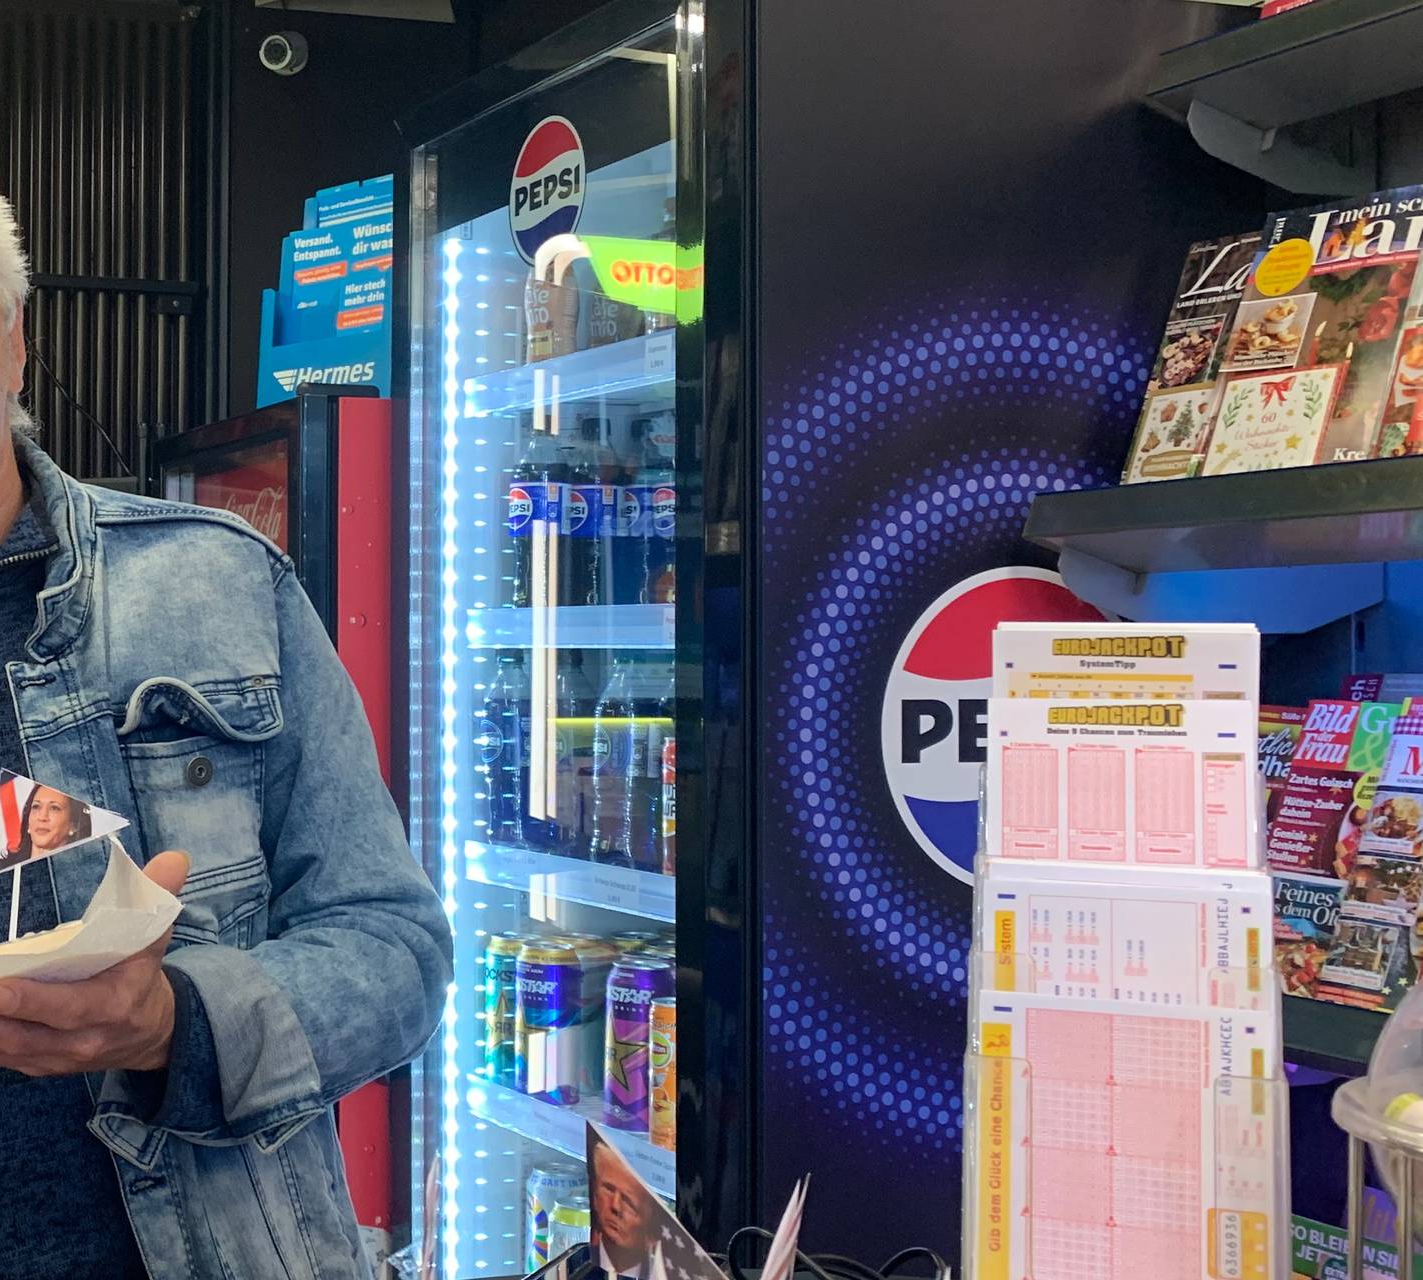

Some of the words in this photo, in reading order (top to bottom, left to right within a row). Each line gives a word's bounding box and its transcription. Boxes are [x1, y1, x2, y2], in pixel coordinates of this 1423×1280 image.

[514, 164, 581, 217] PEPSI
[1339, 198, 1391, 224] mein
[294, 233, 333, 249] Versand.
[352, 241, 369, 255] dir
[293, 246, 342, 262] Entspannt.
[344, 284, 362, 295] Hier
[367, 291, 385, 303] drin
[297, 361, 375, 386] Hermes
[1260, 411, 1277, 424] 60
[1052, 635, 1187, 658] EUROJACKPOT
[1079, 660, 1136, 669] SystemTipp
[1048, 704, 1185, 727] EUROJACKPOT
[1303, 703, 1359, 733] Bild
[902, 699, 988, 763] PE
[1317, 731, 1338, 741] der
[1294, 733, 1350, 763] Frau
[1289, 774, 1318, 786] Zartes
[1319, 776, 1354, 789] Gulasch
[1280, 807, 1312, 818] daheim
[1276, 881, 1335, 907] Feines
[1283, 903, 1311, 918] dem
[990, 1116, 1002, 1146] eine
[989, 1152, 1002, 1189] Glück
[989, 1195, 1001, 1223] dem
[989, 1229, 1001, 1252] Gib
